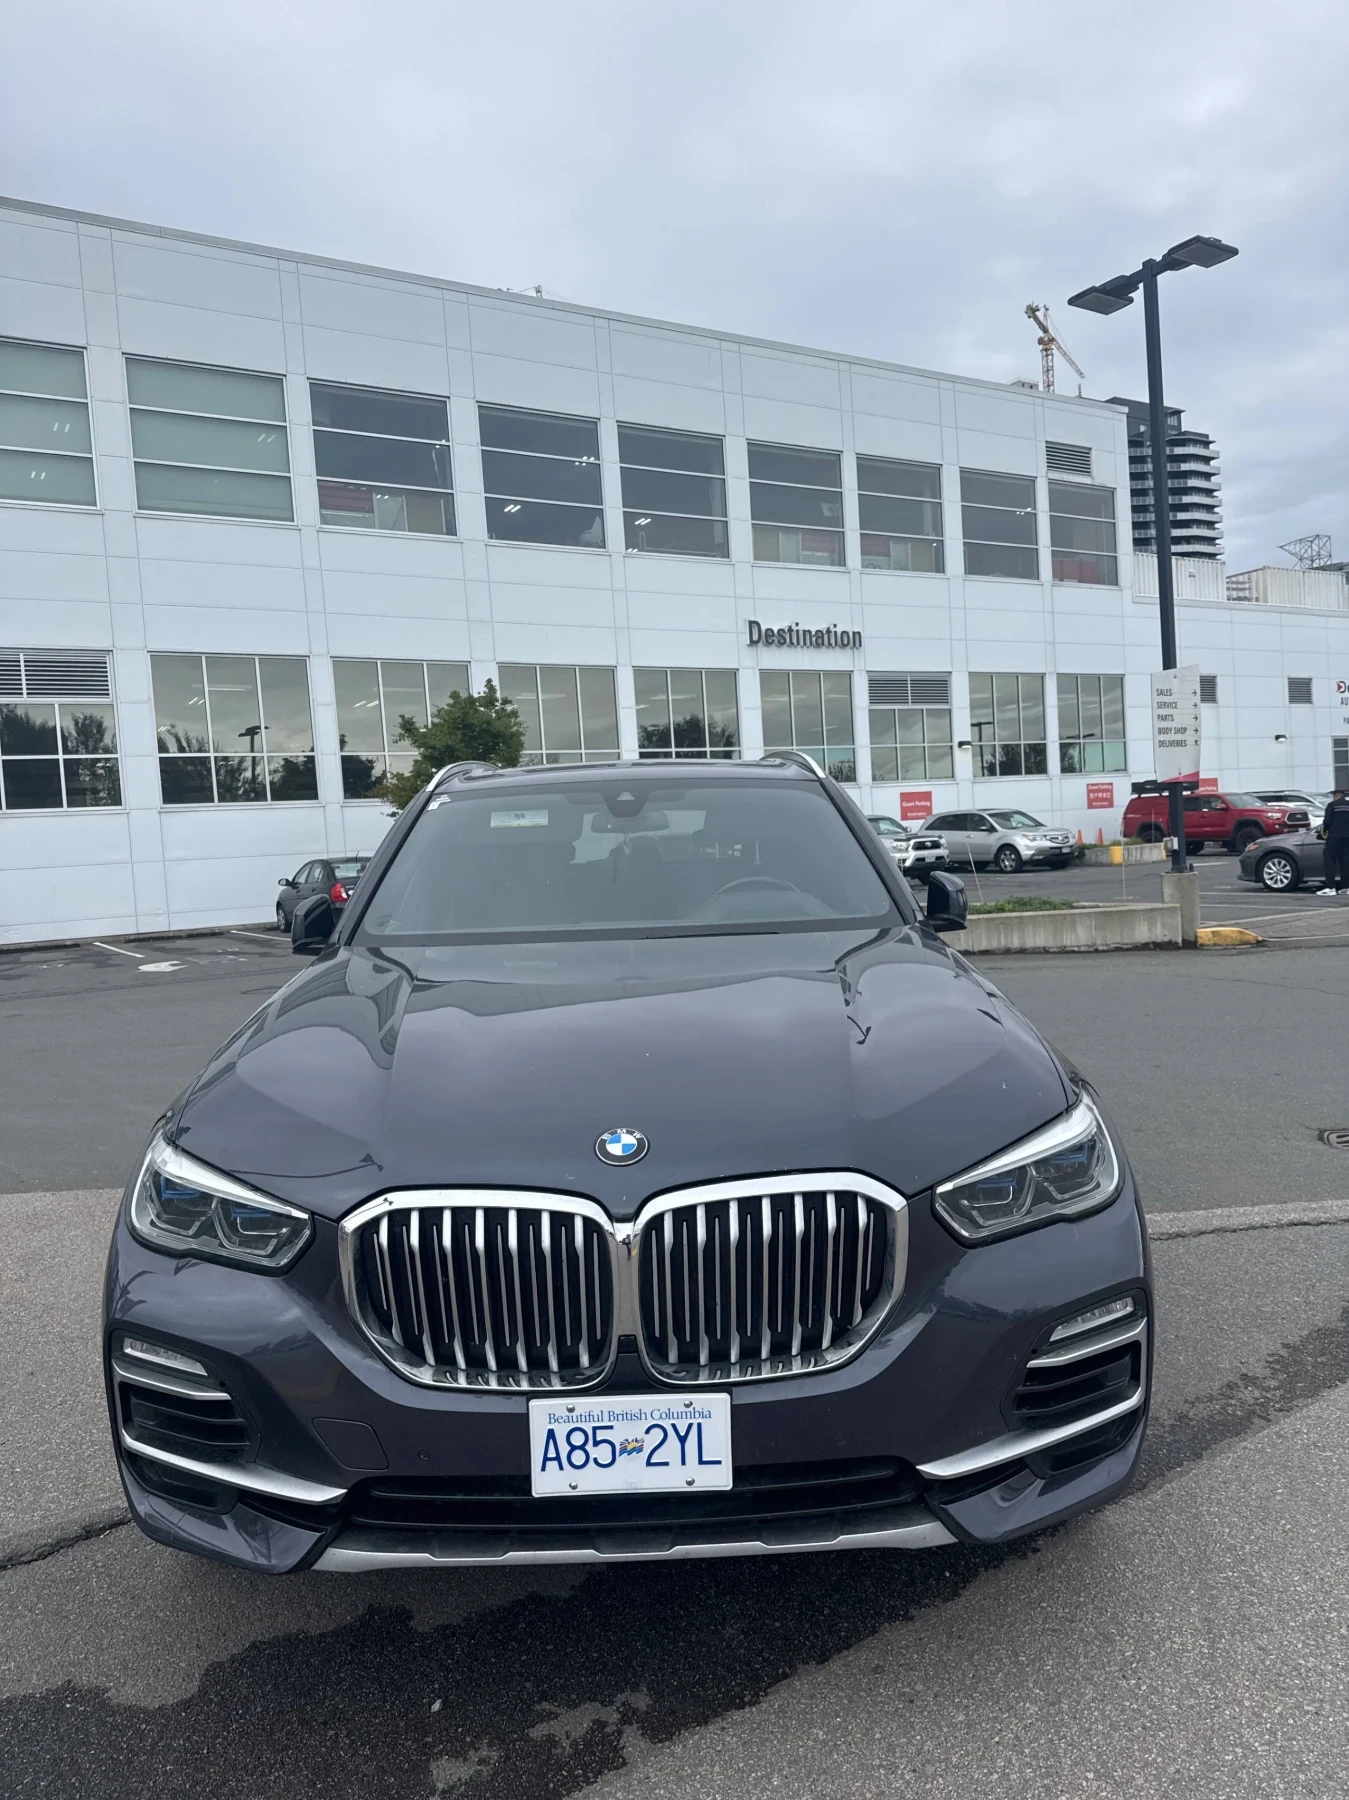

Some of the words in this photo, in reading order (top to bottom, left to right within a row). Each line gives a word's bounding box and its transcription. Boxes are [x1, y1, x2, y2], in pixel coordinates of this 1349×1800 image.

[747, 619, 862, 648] Destination
[1155, 688, 1173, 697] SALES
[1156, 701, 1178, 710] SERVICE
[1157, 714, 1174, 722] PARTS
[1158, 727, 1172, 735] BODY
[1173, 726, 1187, 735] SHOP
[1158, 739, 1187, 748] DELIVERIES
[547, 1412, 604, 1425] Beautiful
[607, 1408, 648, 1422] British
[650, 1406, 712, 1421] Columbia
[540, 1425, 617, 1472] A85
[644, 1421, 722, 1467] 2YL
